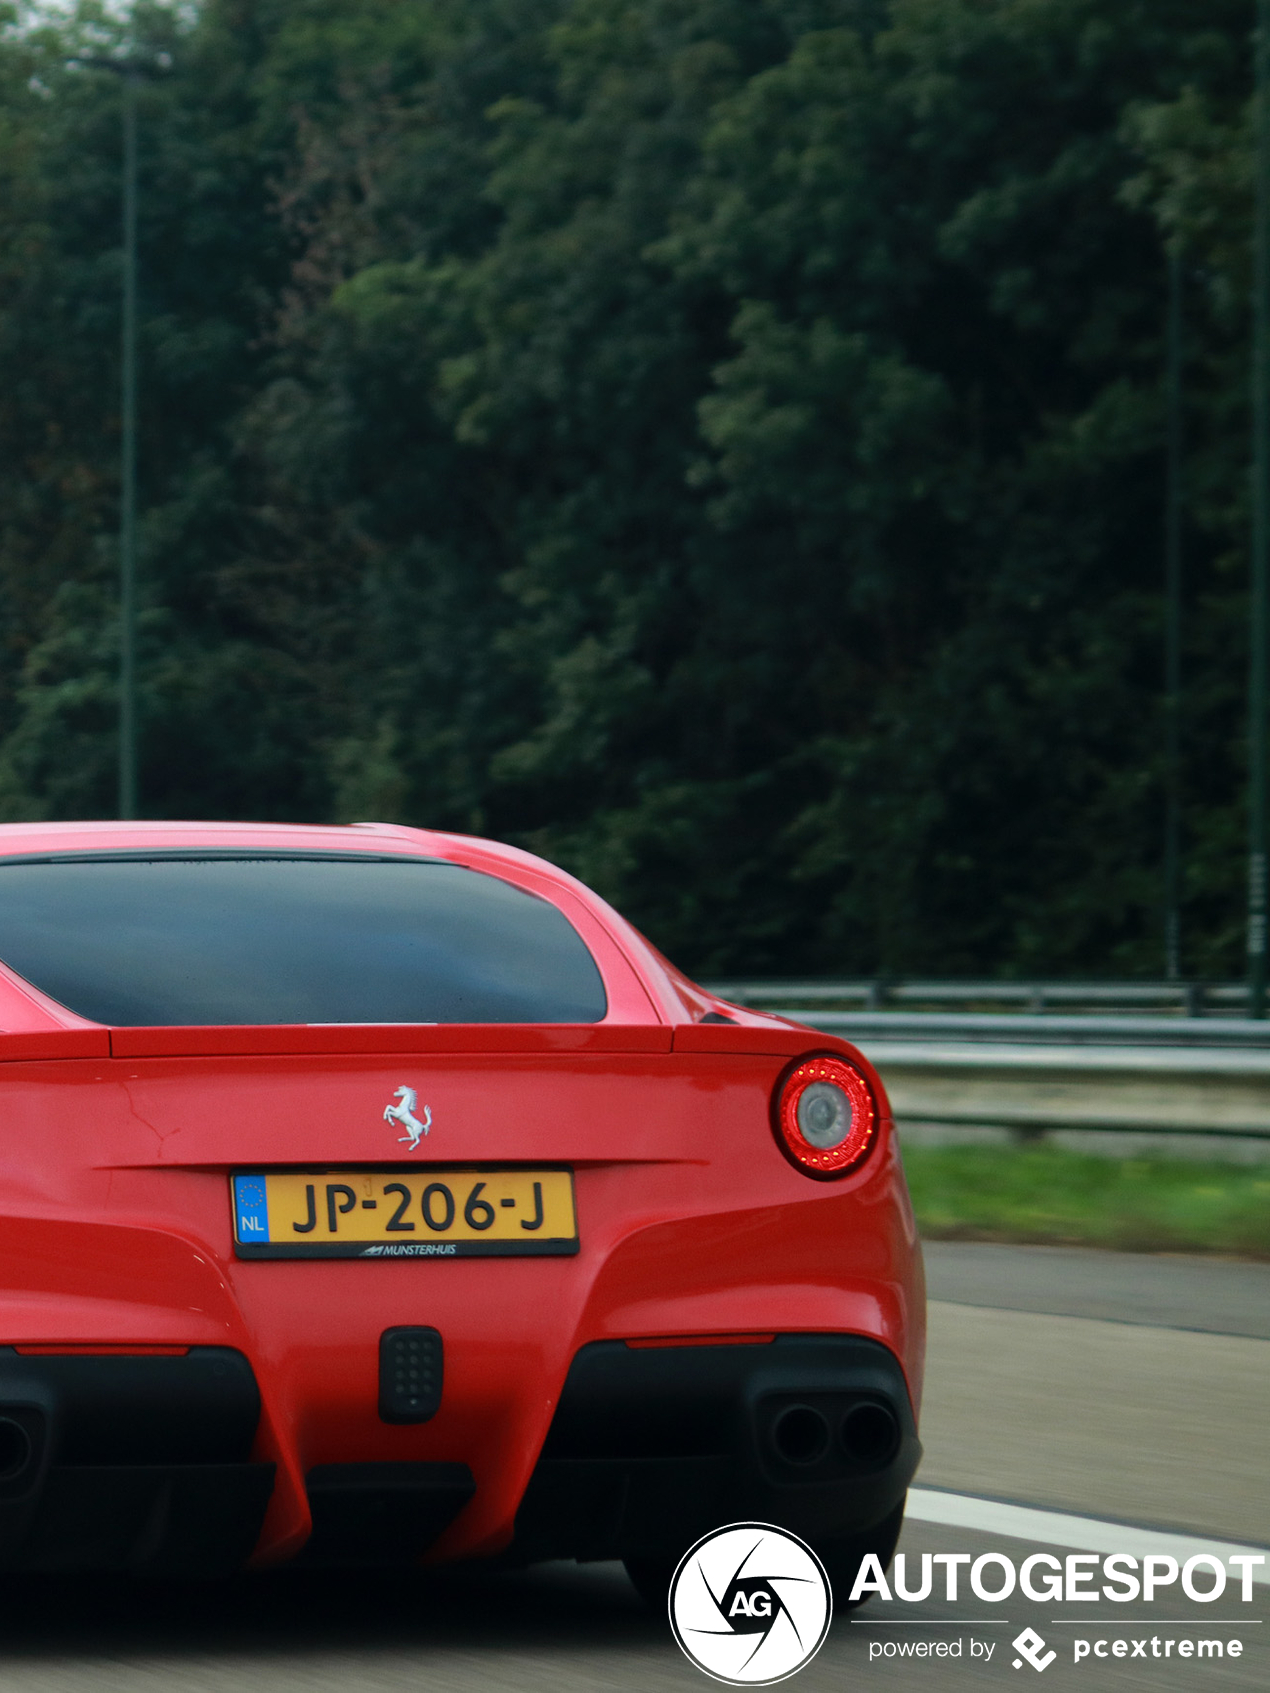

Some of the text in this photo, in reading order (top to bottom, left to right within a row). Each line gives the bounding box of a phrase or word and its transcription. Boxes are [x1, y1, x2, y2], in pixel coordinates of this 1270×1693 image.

[292, 1181, 545, 1233] JP-206-J
[242, 1216, 265, 1231] NL
[382, 1244, 457, 1256] MUNSTERHUIS
